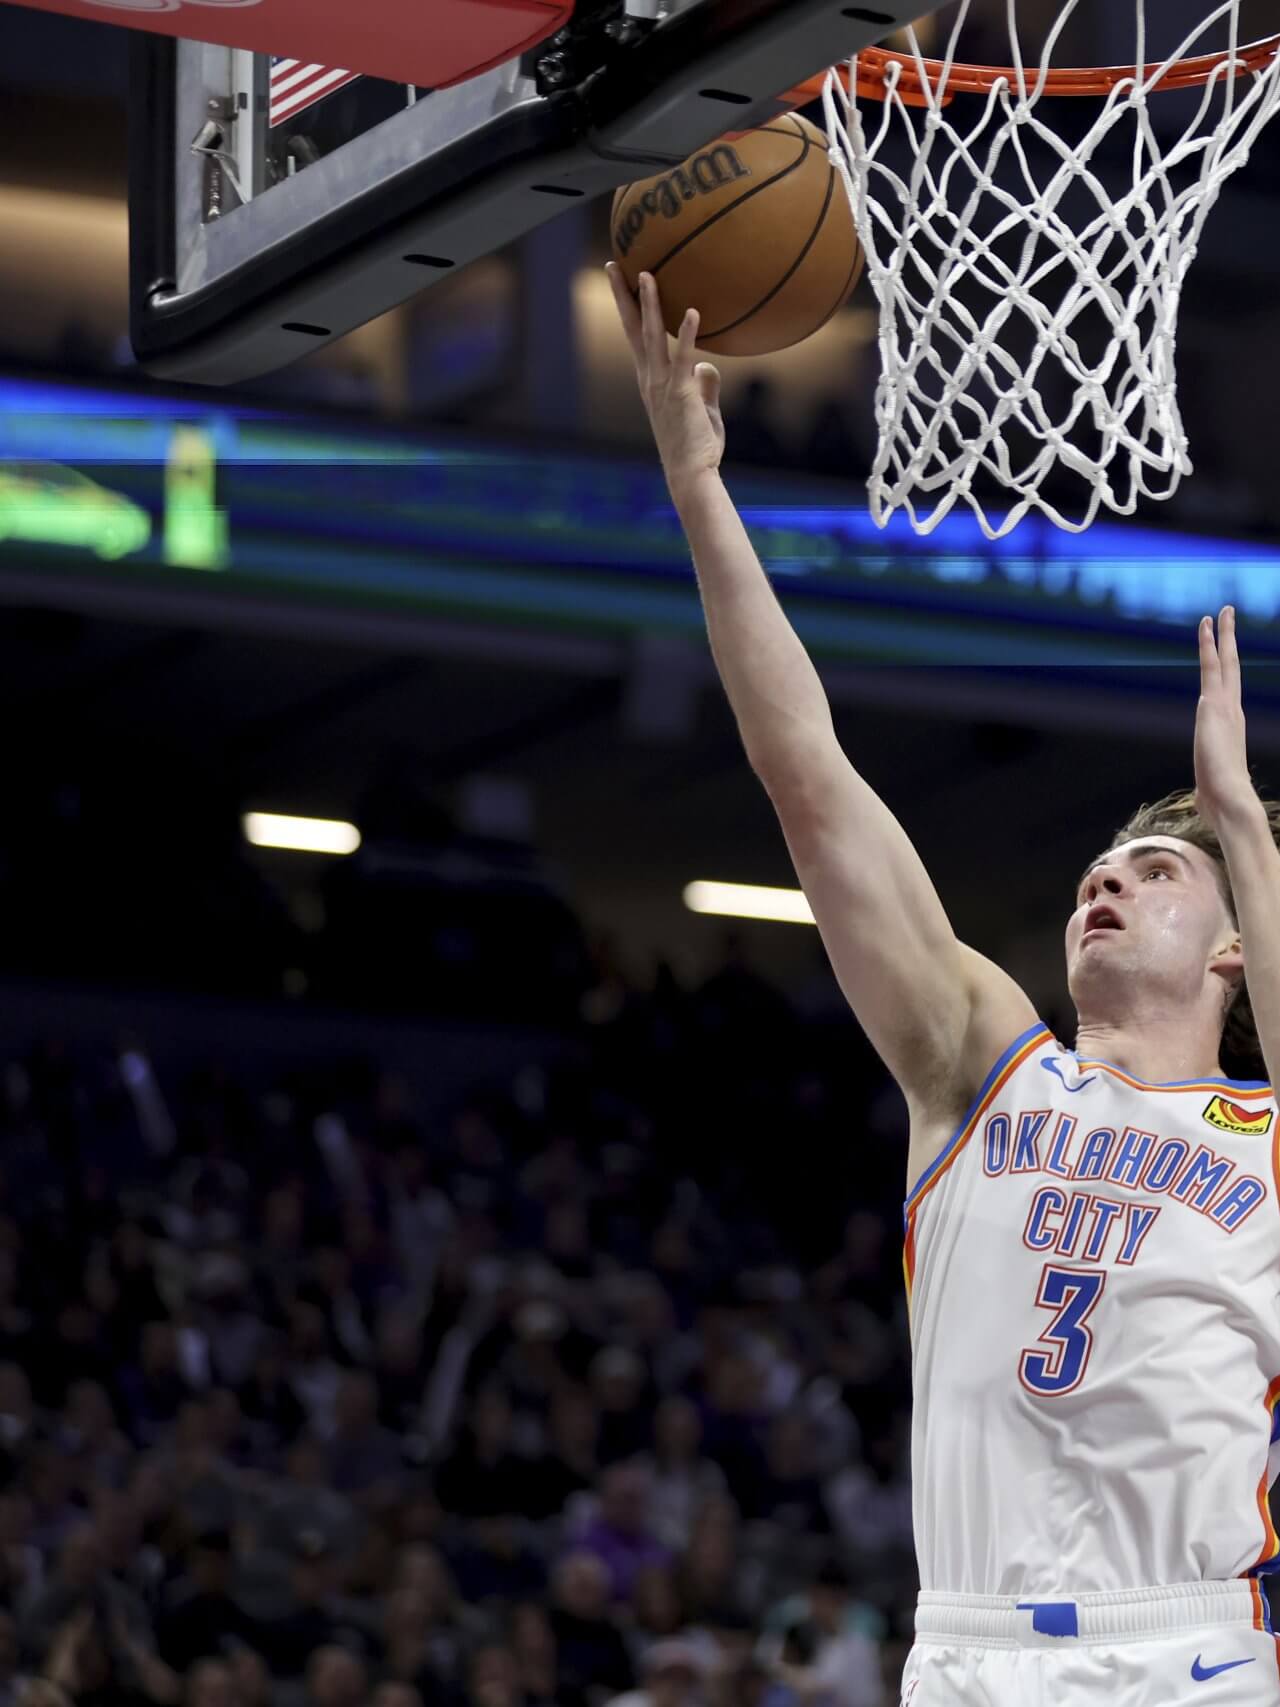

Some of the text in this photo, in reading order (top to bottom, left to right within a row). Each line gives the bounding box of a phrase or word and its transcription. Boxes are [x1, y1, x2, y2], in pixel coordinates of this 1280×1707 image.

[616, 143, 751, 257] Wilson
[983, 1109, 1267, 1234] OKLAHOMA
[1022, 1186, 1161, 1265] CITY
[1018, 1263, 1106, 1397] 3
